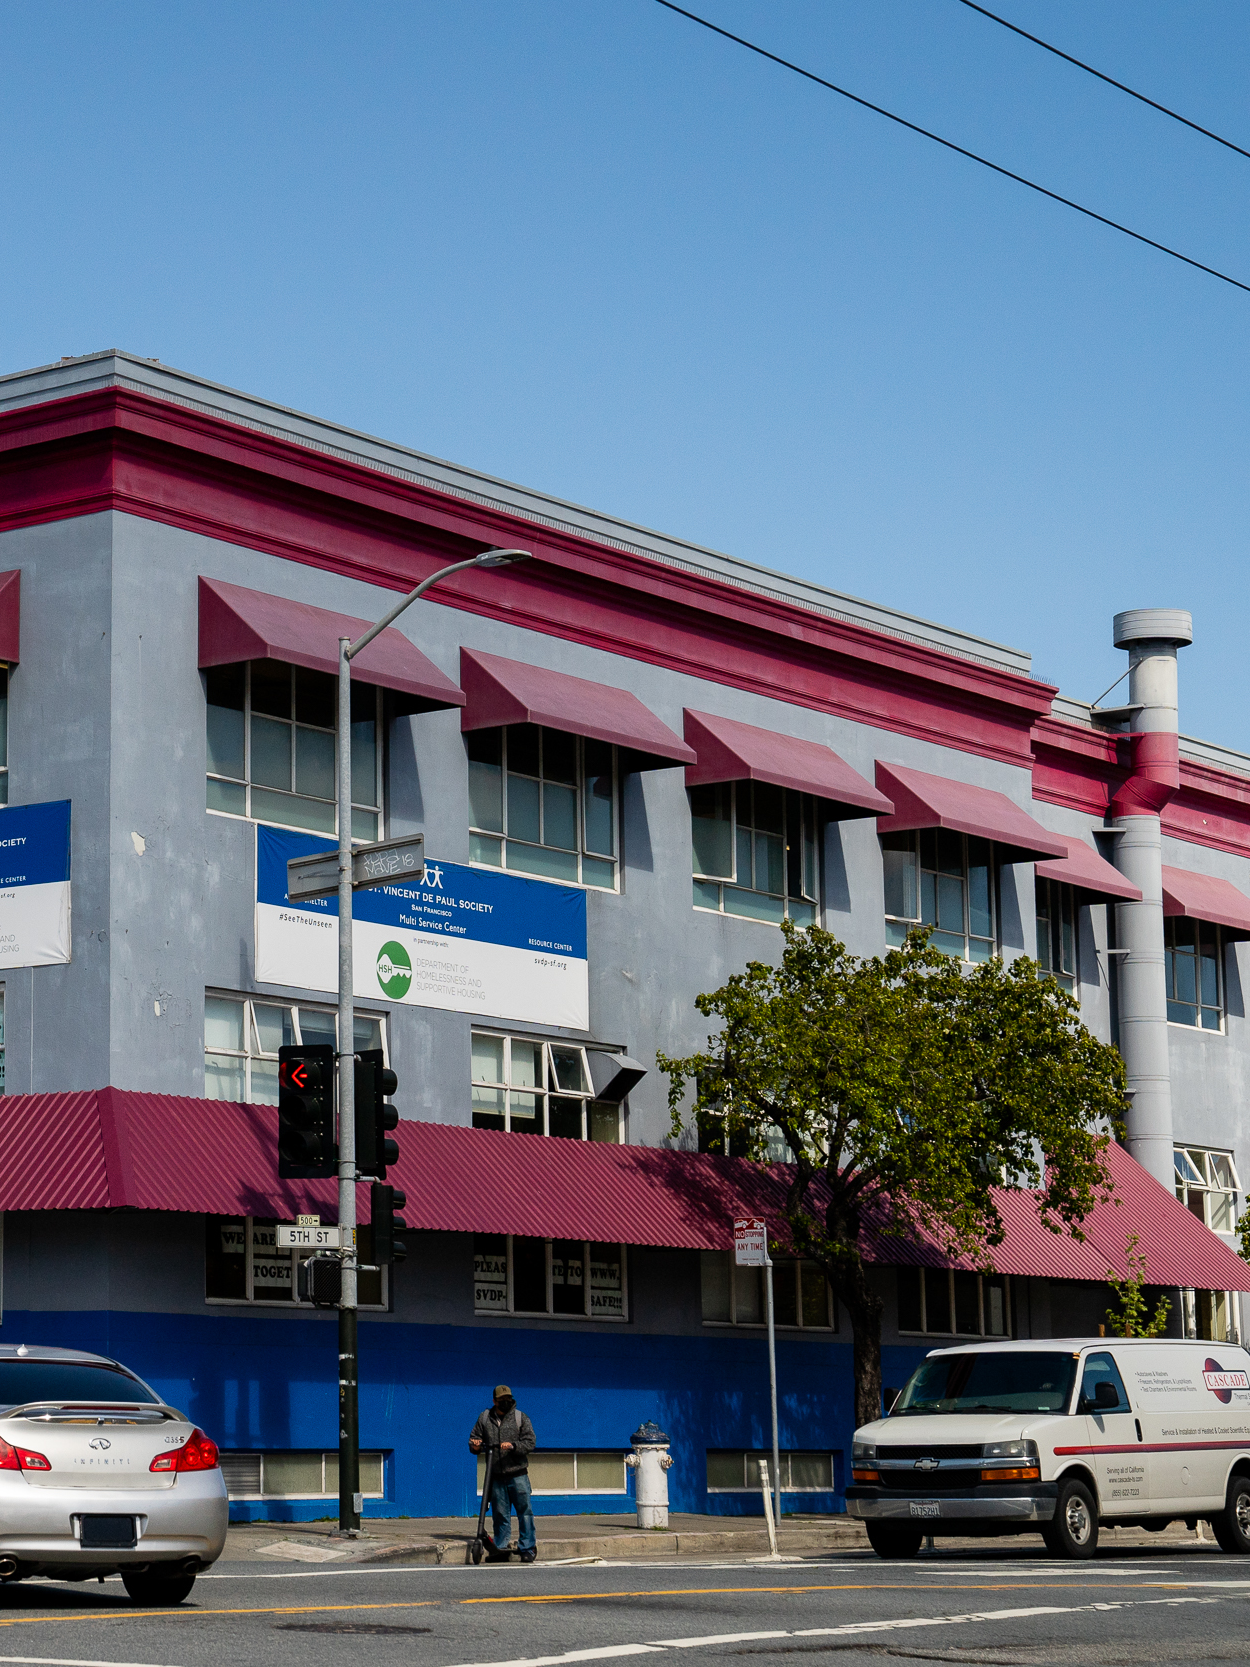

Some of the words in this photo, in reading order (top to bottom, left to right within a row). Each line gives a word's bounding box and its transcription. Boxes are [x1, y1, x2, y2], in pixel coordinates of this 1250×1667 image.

[5, 876, 26, 884] CENTER
[383, 886, 420, 900] VINCENT
[422, 892, 434, 902] DE
[436, 894, 457, 908] PAUL
[459, 900, 494, 914] SOCIETY
[411, 904, 423, 912] SAN
[423, 906, 453, 918] FRANCISCO
[279, 913, 333, 929] #SeeTheUnseen
[399, 914, 417, 926] Multi
[418, 917, 443, 931] Service
[444, 922, 467, 935] Center
[0, 934, 16, 943] AND
[528, 938, 553, 950] RESOURCE
[554, 941, 573, 952] CENTER
[378, 963, 393, 975] HSH
[416, 957, 461, 970] DEPARTMENT
[461, 965, 470, 974] OF
[534, 957, 567, 971] svdp-sf.org
[416, 970, 466, 985] HOMELESSNESS
[467, 978, 482, 988] AND
[416, 981, 456, 996] SUPPORTIVE
[456, 988, 486, 1001] HOUSING
[301, 1217, 313, 1225] 500
[222, 1232, 245, 1245] WE
[253, 1232, 276, 1246] ARE
[290, 1231, 310, 1243] 5TH
[317, 1232, 329, 1244] ST
[737, 1242, 749, 1251] ANY
[750, 1242, 764, 1251] TIME
[1206, 1374, 1247, 1387] CASCADE
